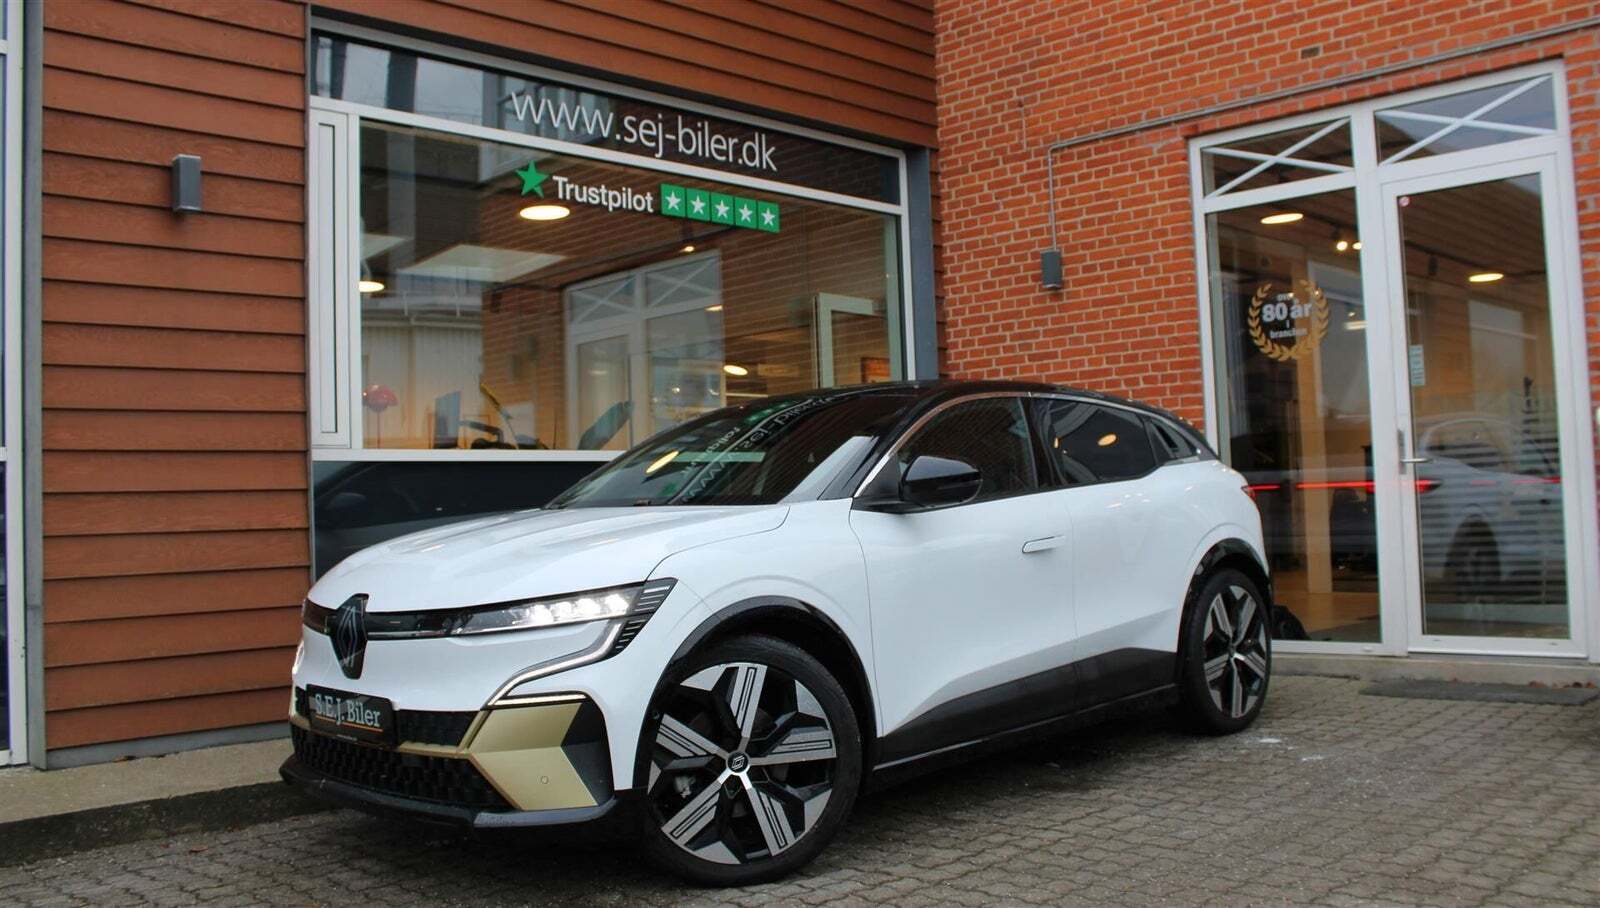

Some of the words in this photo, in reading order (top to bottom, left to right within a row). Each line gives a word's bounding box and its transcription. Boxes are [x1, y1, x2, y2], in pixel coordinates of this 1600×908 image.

[511, 91, 778, 172] www.sej-biler.dk
[552, 174, 654, 212] Trustpilot
[1261, 302, 1288, 323] 80
[346, 699, 381, 728] Biler
